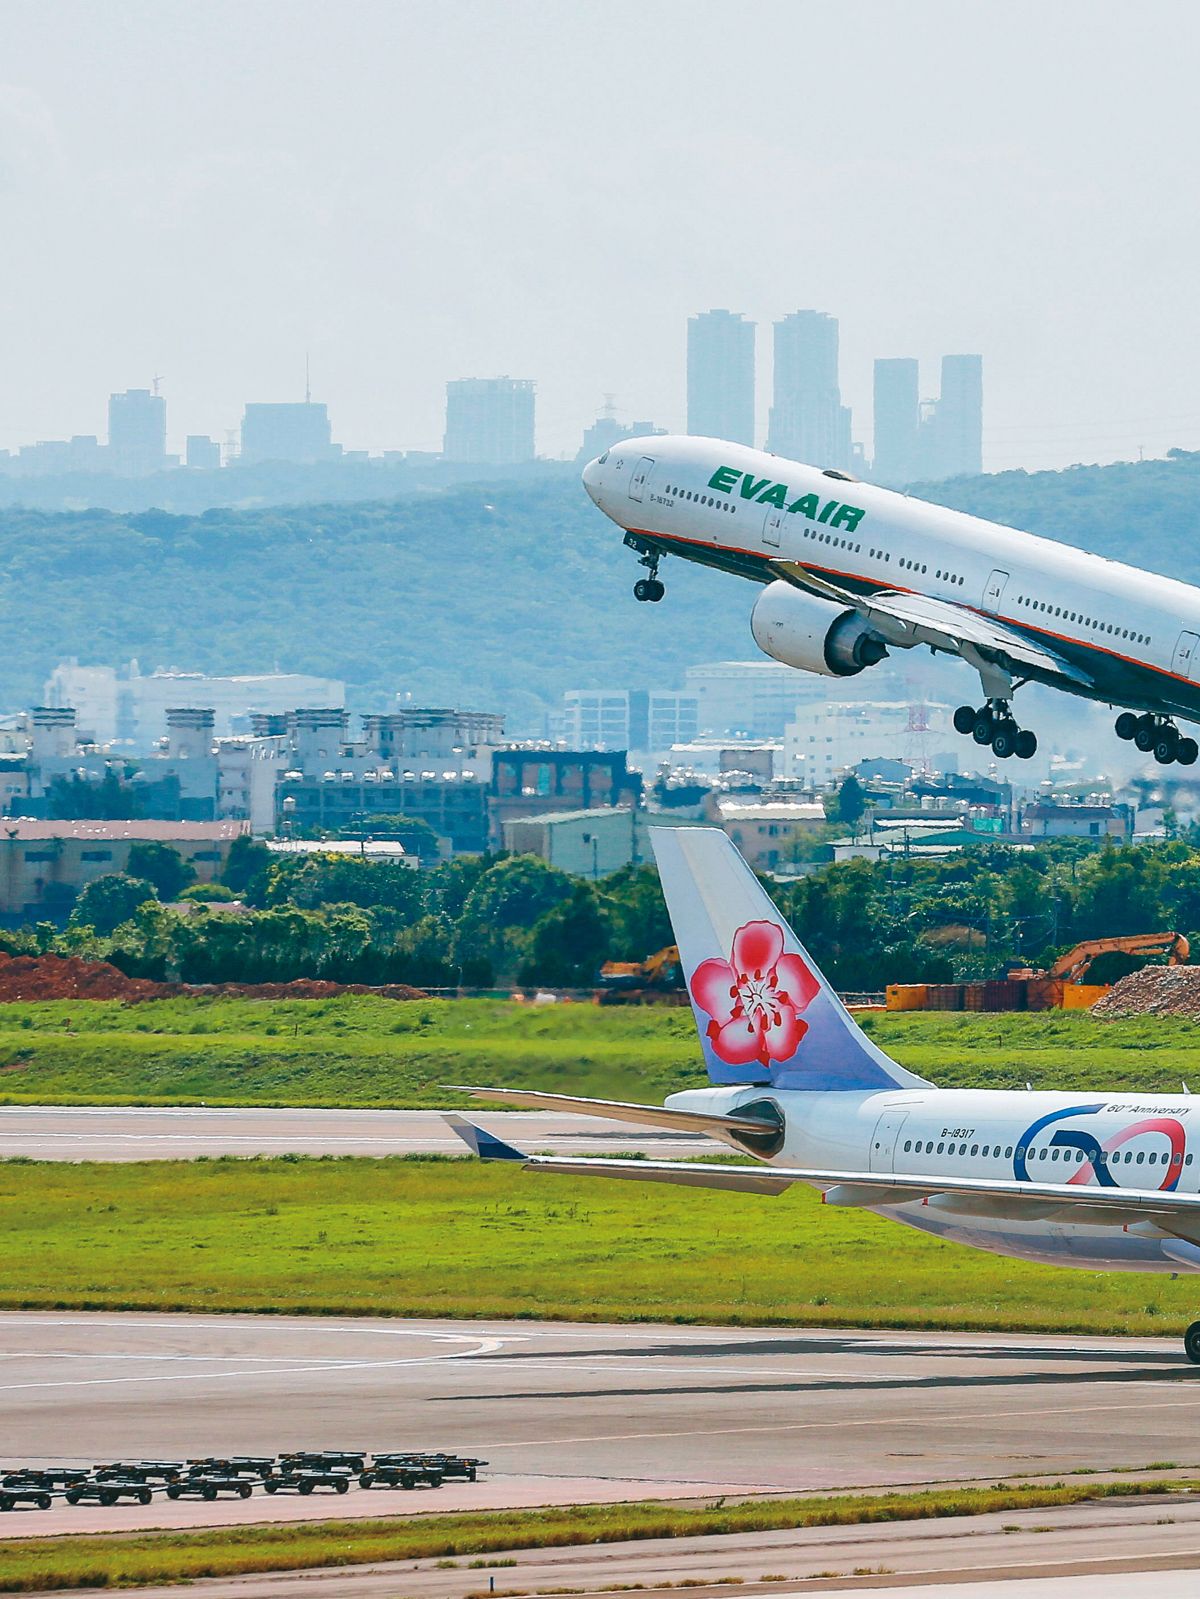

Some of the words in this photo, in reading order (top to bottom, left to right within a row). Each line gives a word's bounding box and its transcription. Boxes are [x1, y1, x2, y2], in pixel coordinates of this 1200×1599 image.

[628, 538, 637, 549] 32
[1128, 1105, 1192, 1116] Anniversary
[940, 1128, 975, 1139] B-18317
